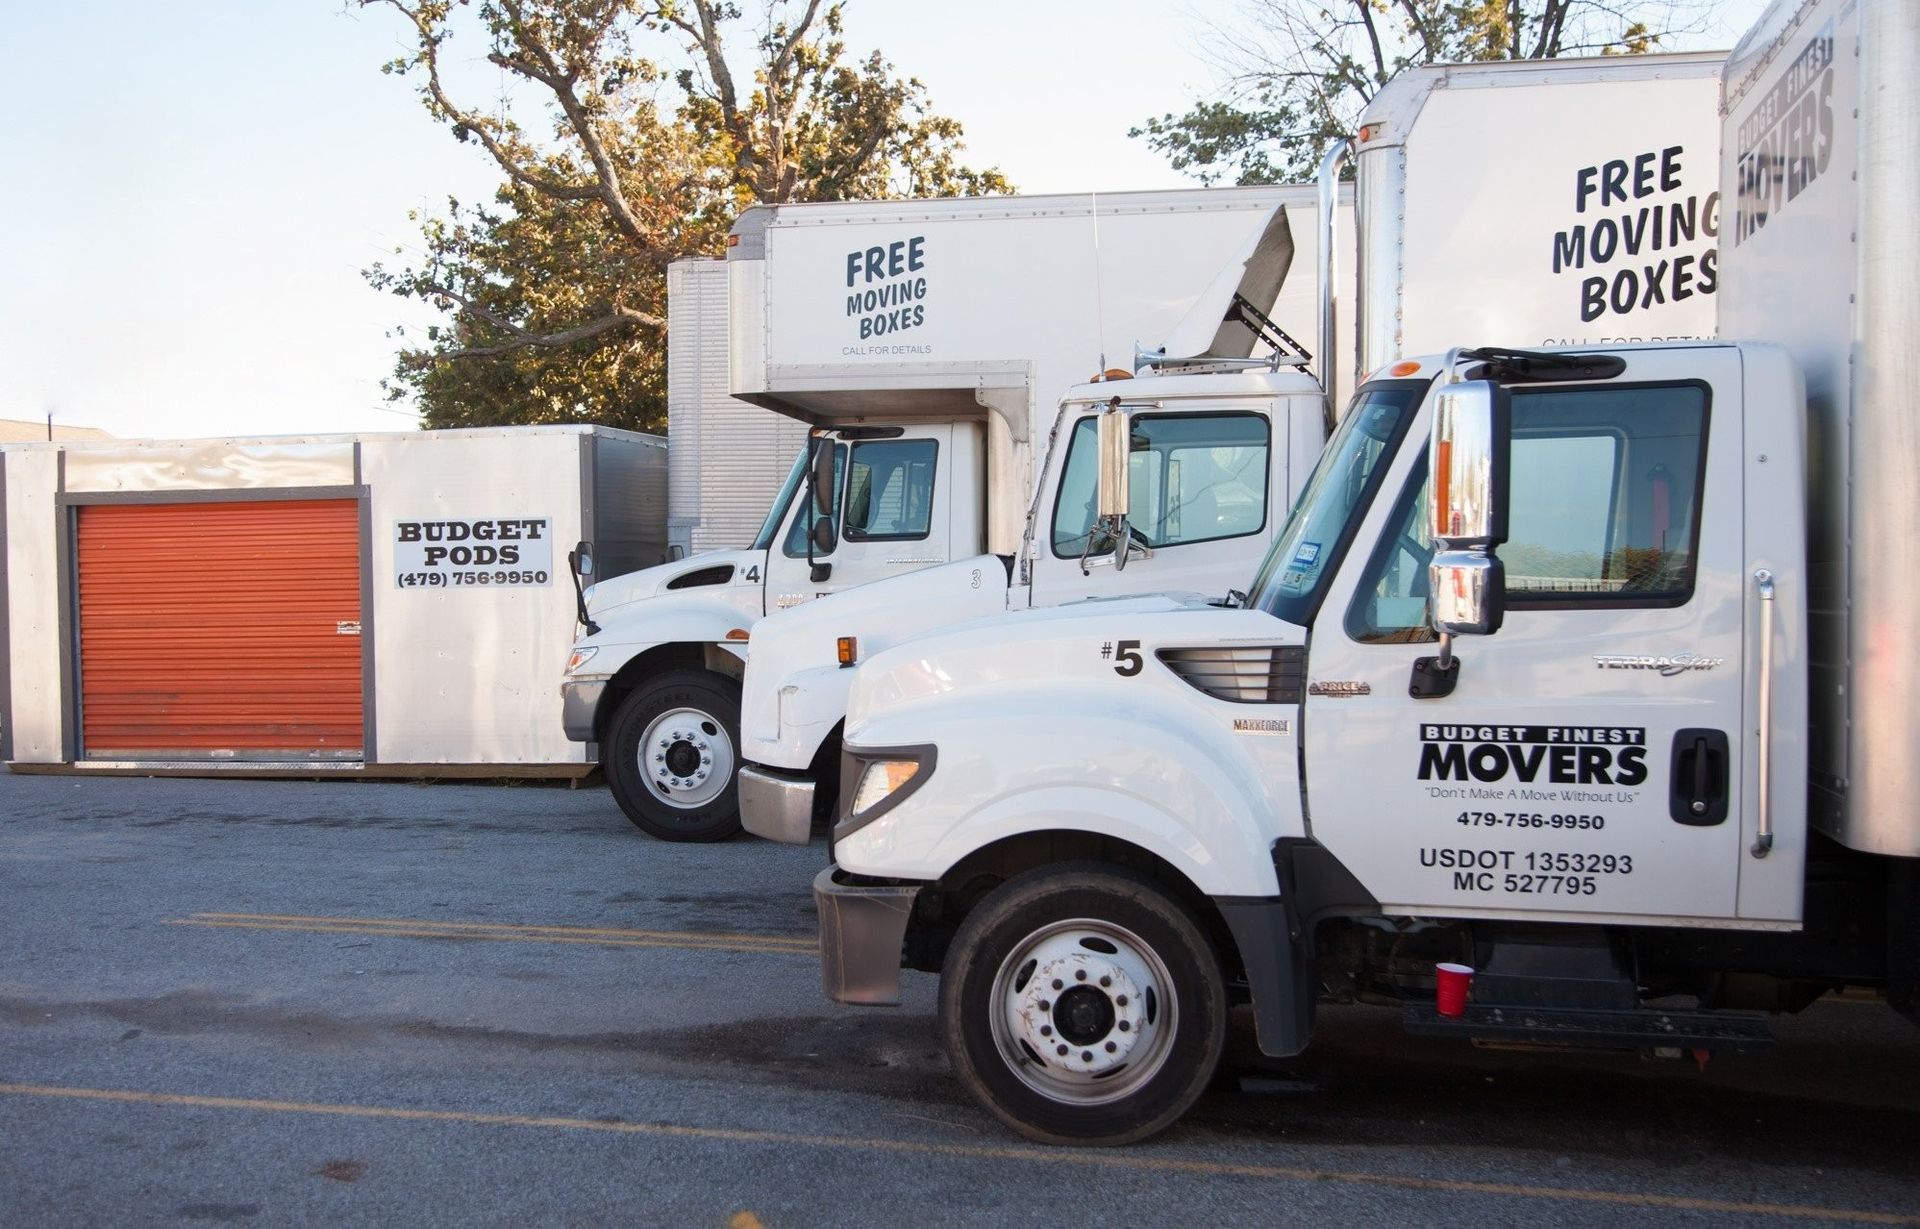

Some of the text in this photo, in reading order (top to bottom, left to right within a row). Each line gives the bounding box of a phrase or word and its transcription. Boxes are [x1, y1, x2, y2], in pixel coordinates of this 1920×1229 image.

[1739, 88, 1780, 153] BUDGET
[1735, 67, 1834, 248] MOVERS
[1576, 145, 1684, 214] FREE
[1553, 191, 1719, 274] MOVING
[846, 235, 925, 288] FREE
[846, 277, 927, 317] MOVING
[1581, 248, 1718, 323] BOXES
[860, 304, 924, 340] BOXES
[842, 344, 932, 356] CALL FOR DETAILS
[398, 519, 546, 542] BUDGET
[424, 545, 519, 566] PODS
[397, 572, 448, 588] (479)
[740, 565, 761, 583] #4
[971, 568, 982, 590] 3
[1101, 639, 1144, 677] #5
[1319, 681, 1360, 692] PRICE
[1424, 725, 1641, 744] BUDGET FINEST
[1417, 743, 1649, 787] MOVERS
[1469, 787, 1505, 801] Make
[1508, 789, 1519, 800] A
[1521, 789, 1557, 802] Move
[1560, 790, 1614, 803] Without
[1456, 811, 1605, 830] 479-756-9950
[1420, 848, 1633, 874] USDOT 1353293
[1453, 871, 1597, 896] MC 527795
